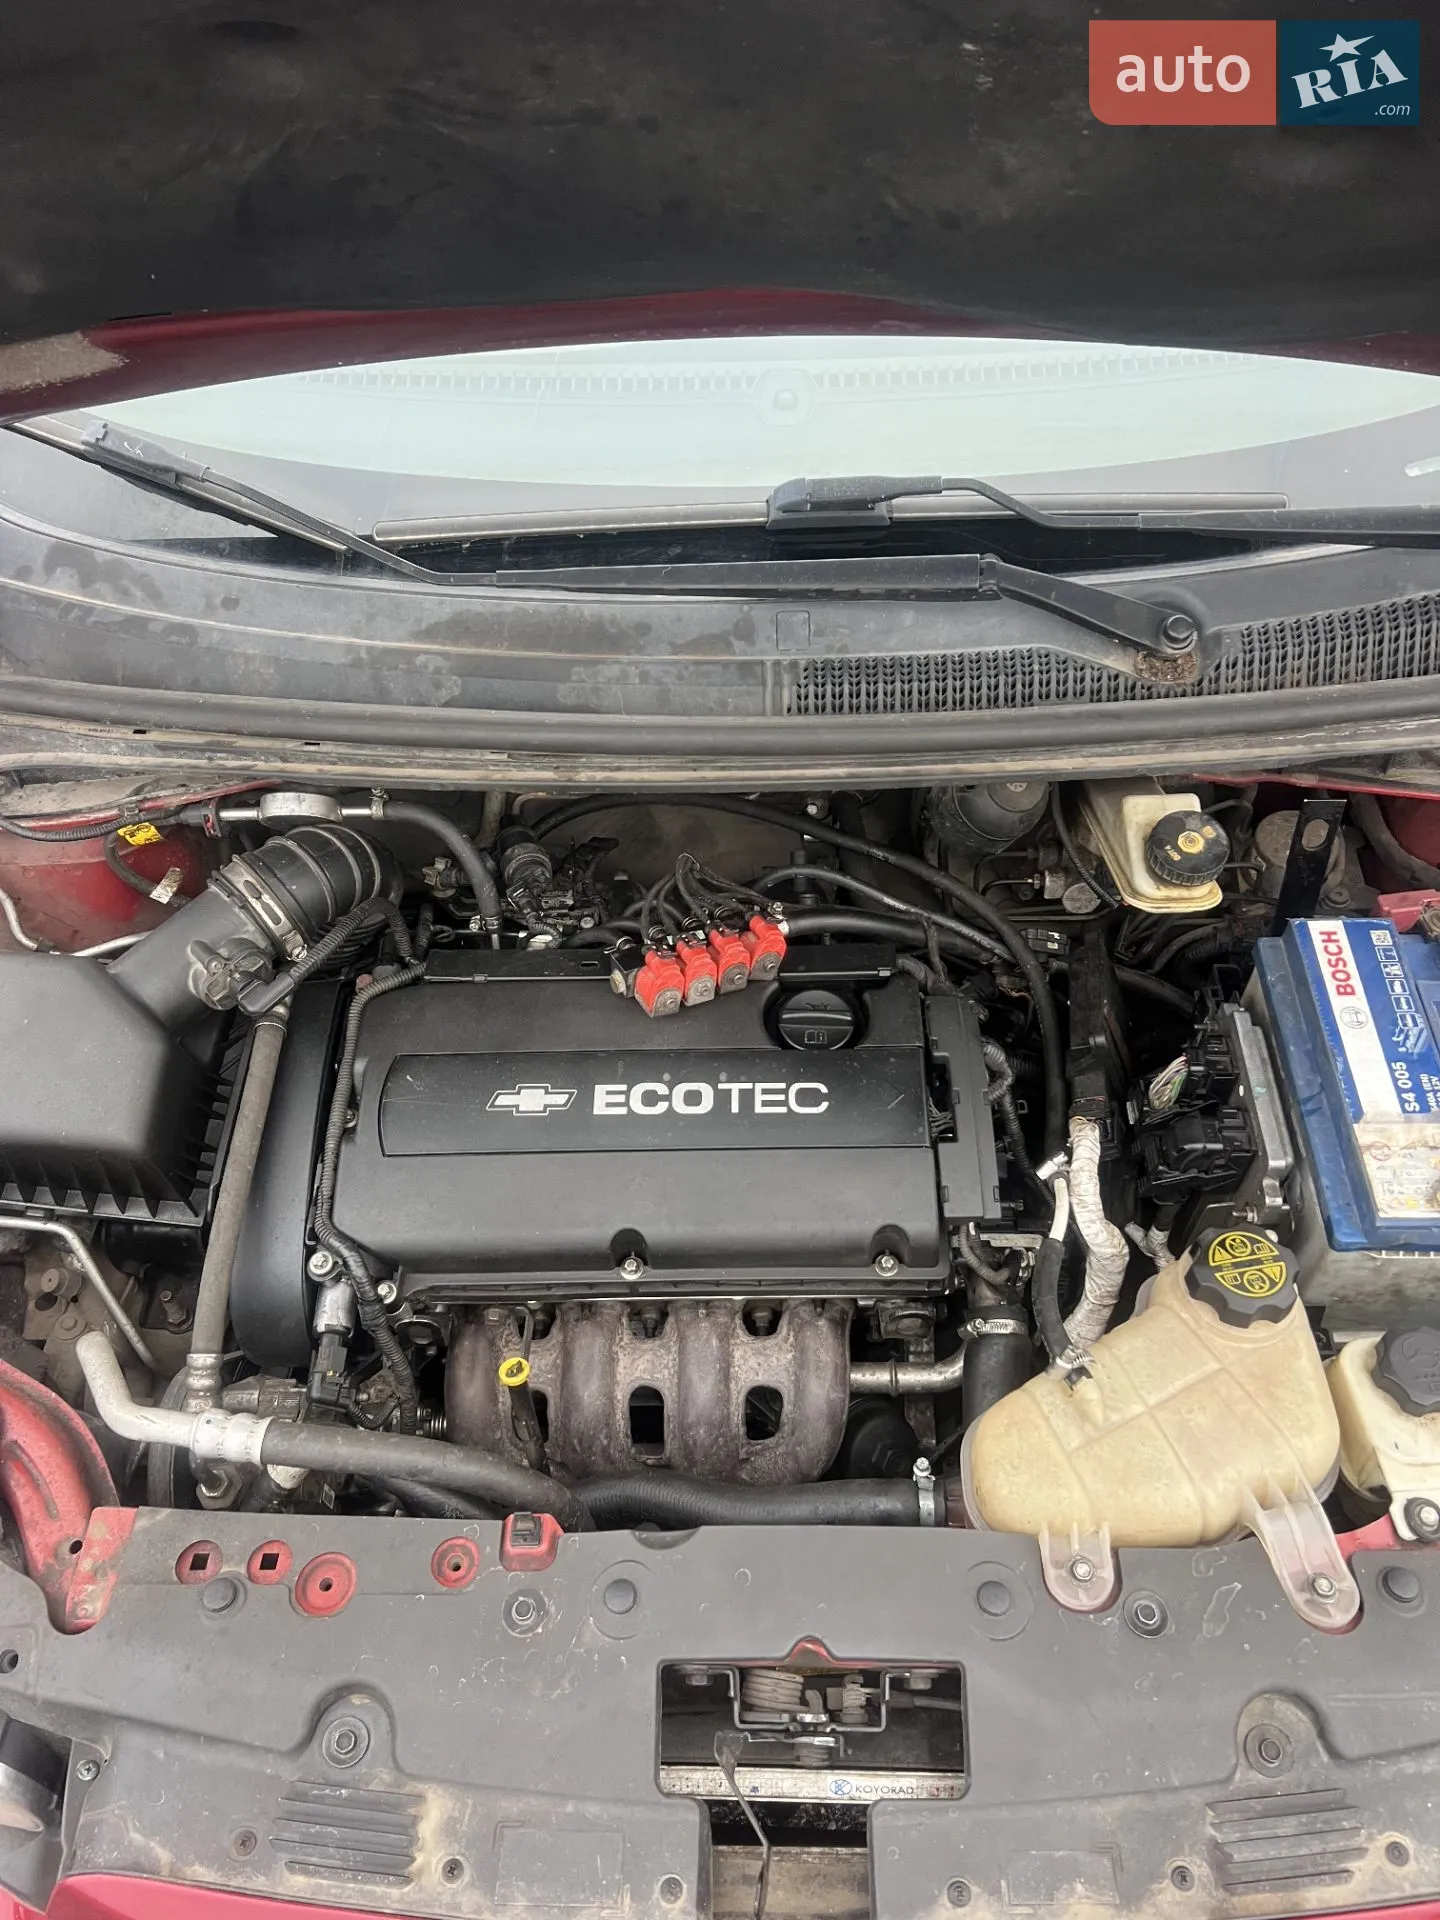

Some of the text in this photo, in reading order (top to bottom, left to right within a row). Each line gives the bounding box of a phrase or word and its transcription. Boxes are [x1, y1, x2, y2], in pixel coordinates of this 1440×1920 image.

[1319, 930, 1356, 996] BOSCH
[593, 1082, 830, 1115] ECOTEC
[1391, 1061, 1420, 1112] S4 005
[855, 1784, 914, 1795] KOYORAD
